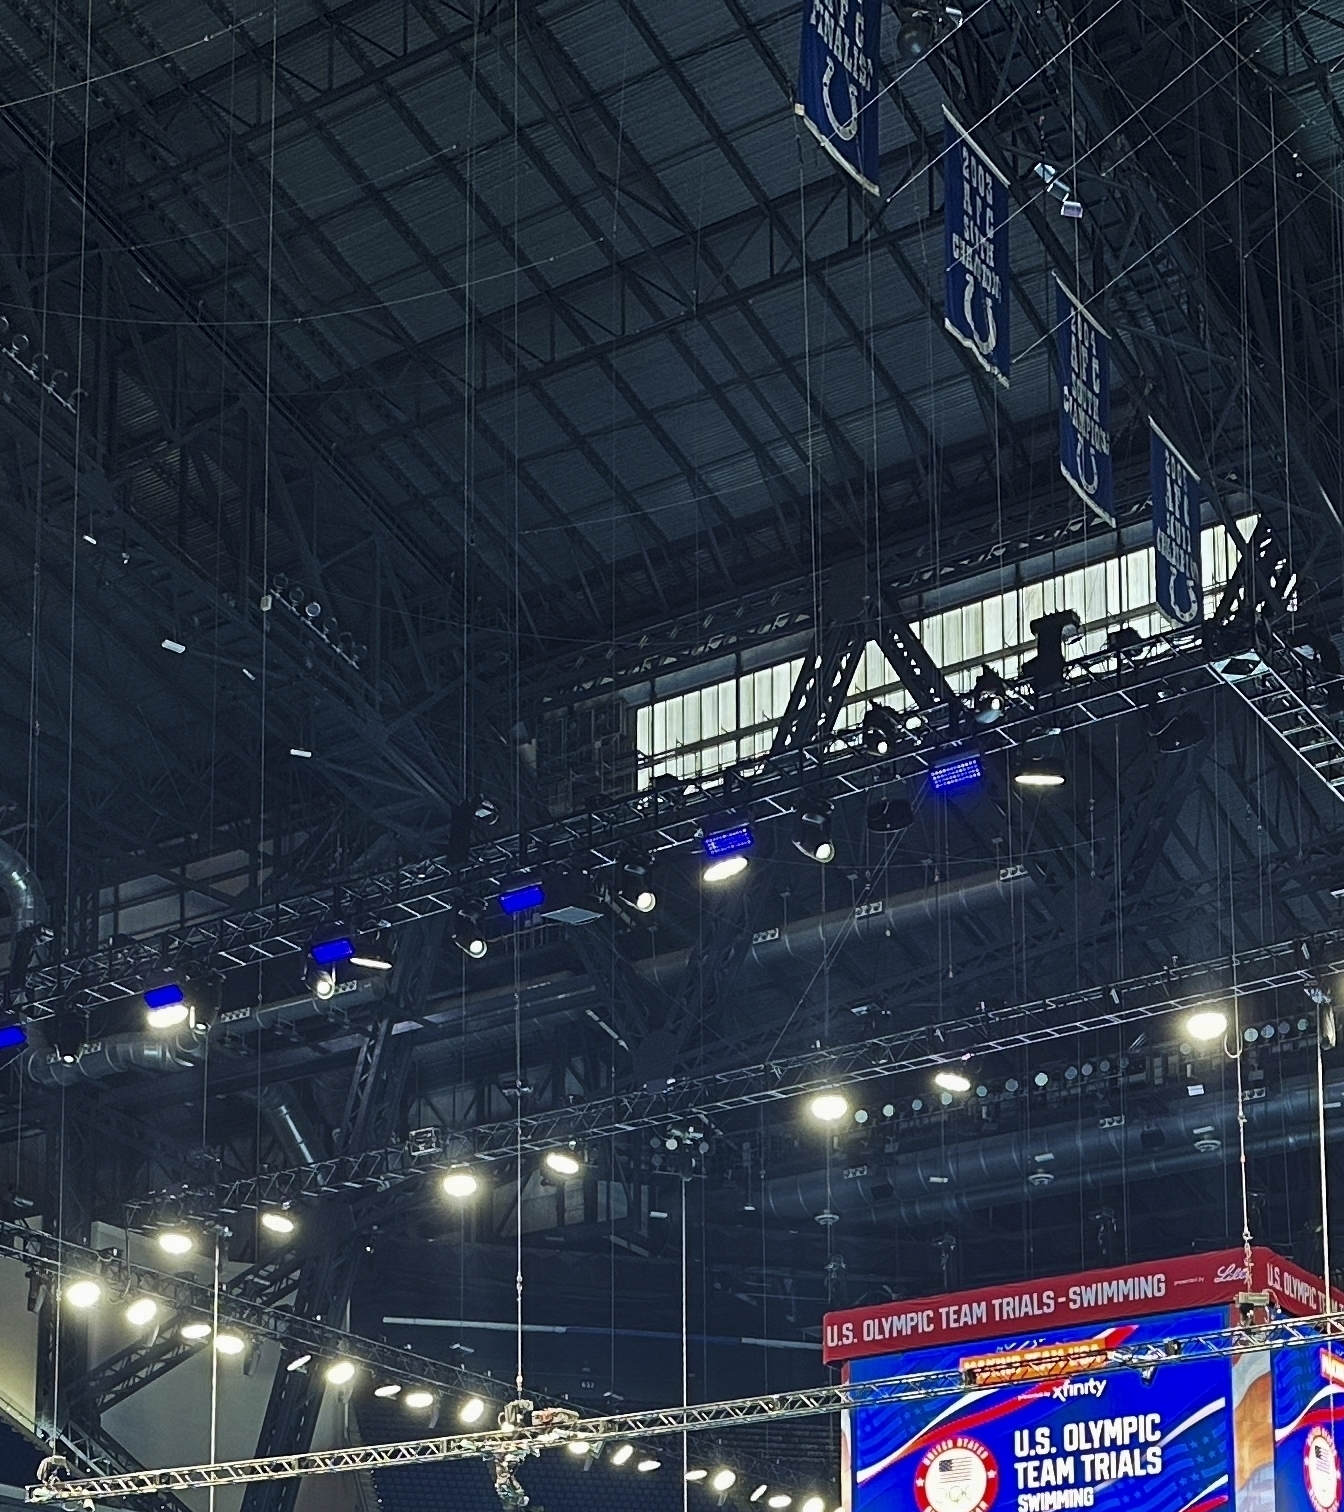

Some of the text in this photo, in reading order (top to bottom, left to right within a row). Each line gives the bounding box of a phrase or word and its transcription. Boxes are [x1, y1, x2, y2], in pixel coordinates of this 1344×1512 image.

[963, 146, 993, 206] 2003
[1267, 1262, 1317, 1310] U.S. OLYMPIC
[826, 1322, 857, 1349] U.S.
[863, 1310, 935, 1342] OLYMPIC
[939, 1301, 988, 1330] TEAM
[1051, 1377, 1107, 1403] xfinity
[1014, 1413, 1161, 1458] U.S. OLYMPIC
[1014, 1446, 1162, 1490] TEAM TRIALS
